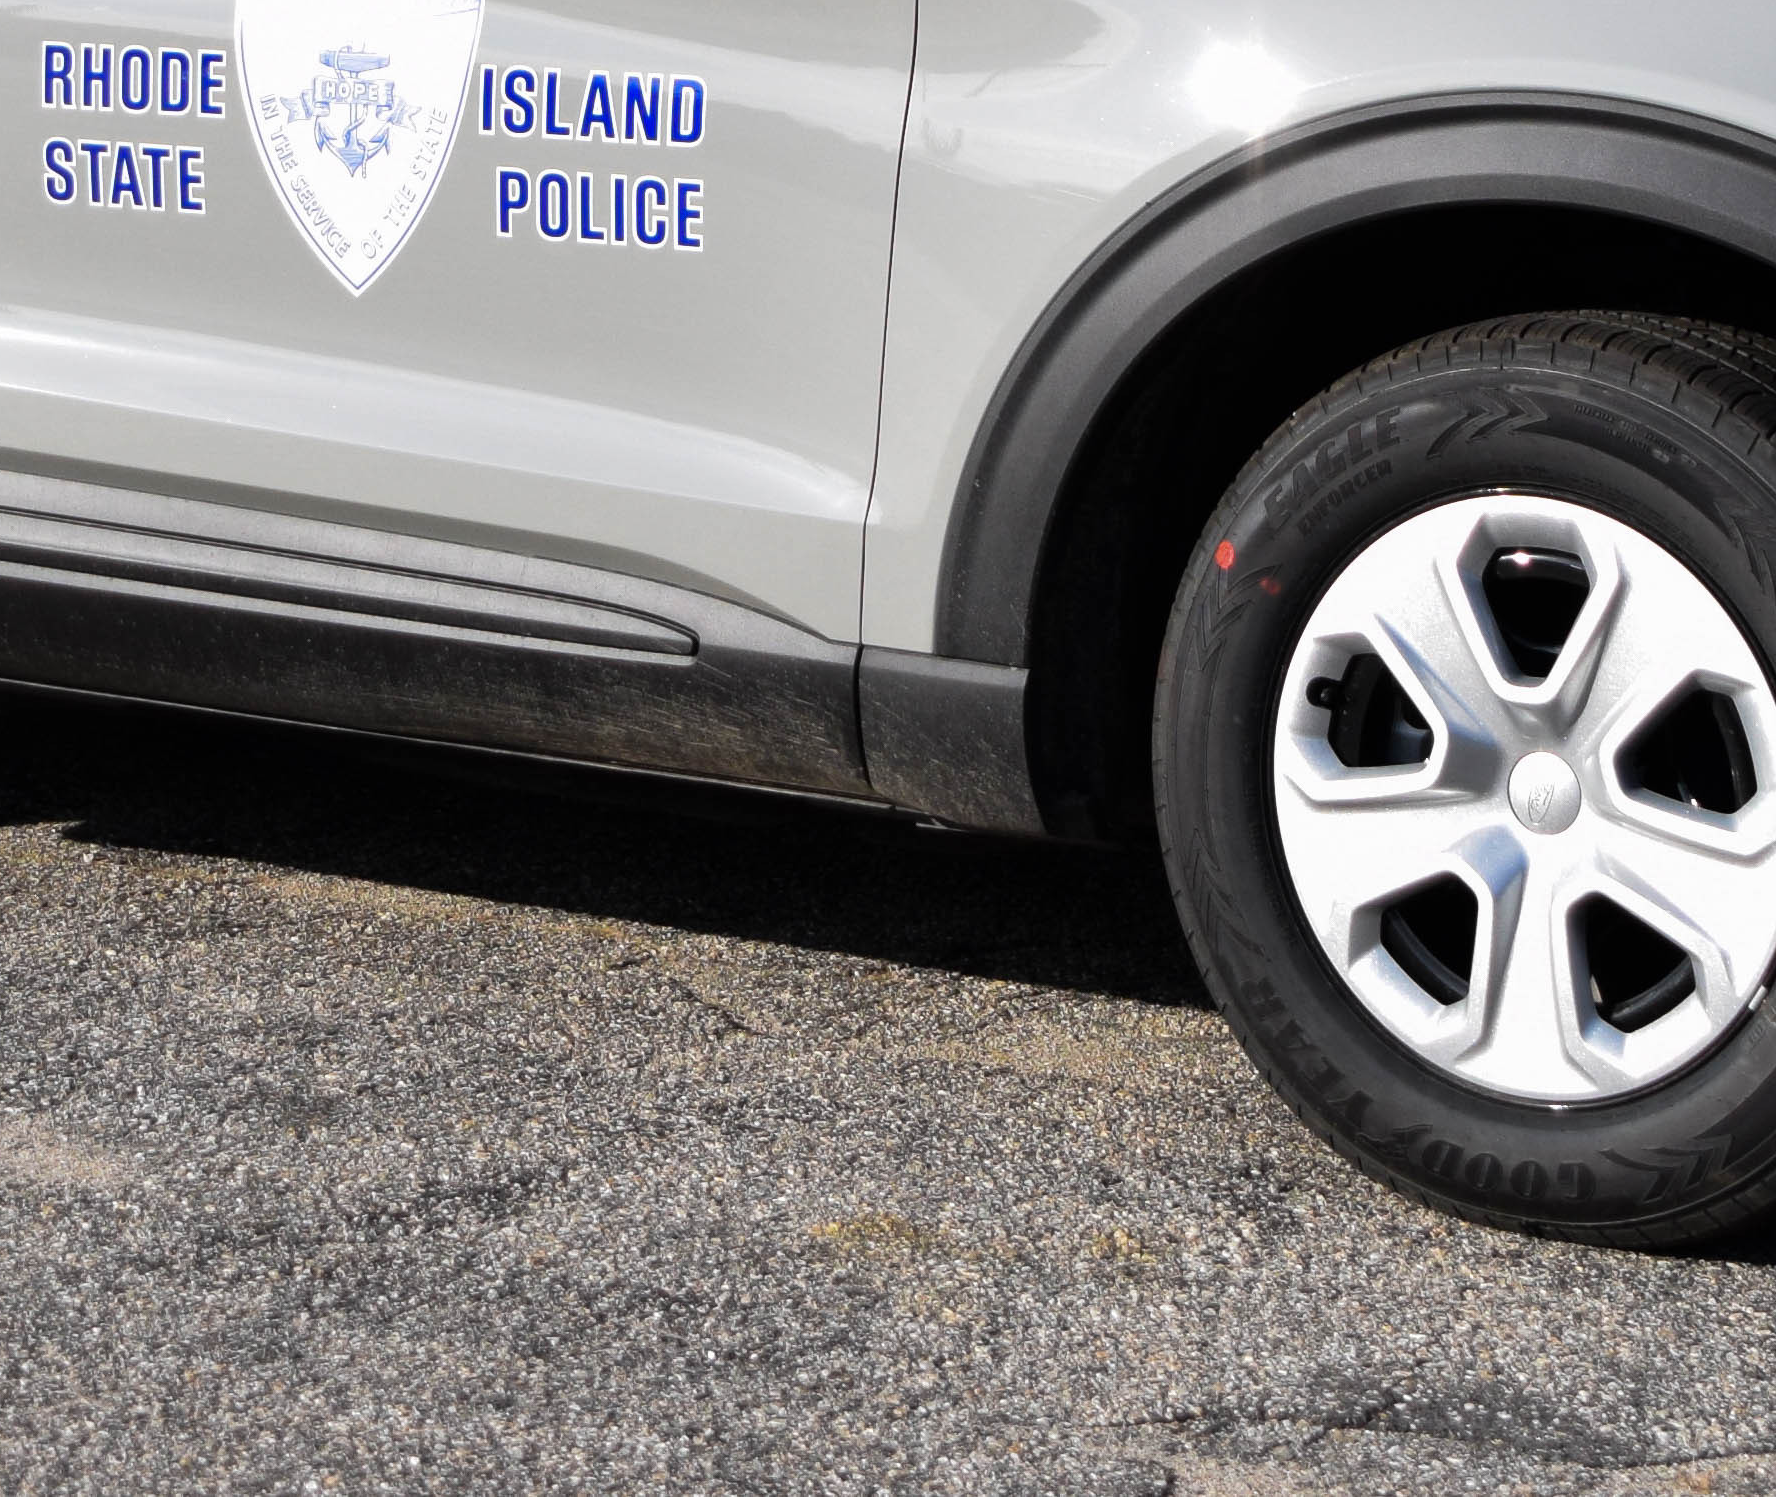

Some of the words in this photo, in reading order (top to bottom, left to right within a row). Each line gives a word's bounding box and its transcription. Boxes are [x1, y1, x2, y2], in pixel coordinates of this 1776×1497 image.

[41, 41, 226, 118] RHODE
[478, 64, 706, 147] ISLAND
[260, 93, 282, 121] IN
[326, 79, 380, 102] HOPE
[270, 125, 299, 173] THE
[411, 107, 449, 180] STATE
[42, 137, 206, 215] STATE
[496, 167, 705, 251] POLICE
[290, 174, 351, 258] SERVICE
[384, 184, 416, 227] THE
[361, 229, 385, 259] OF
[1263, 405, 1401, 532] EAGLE
